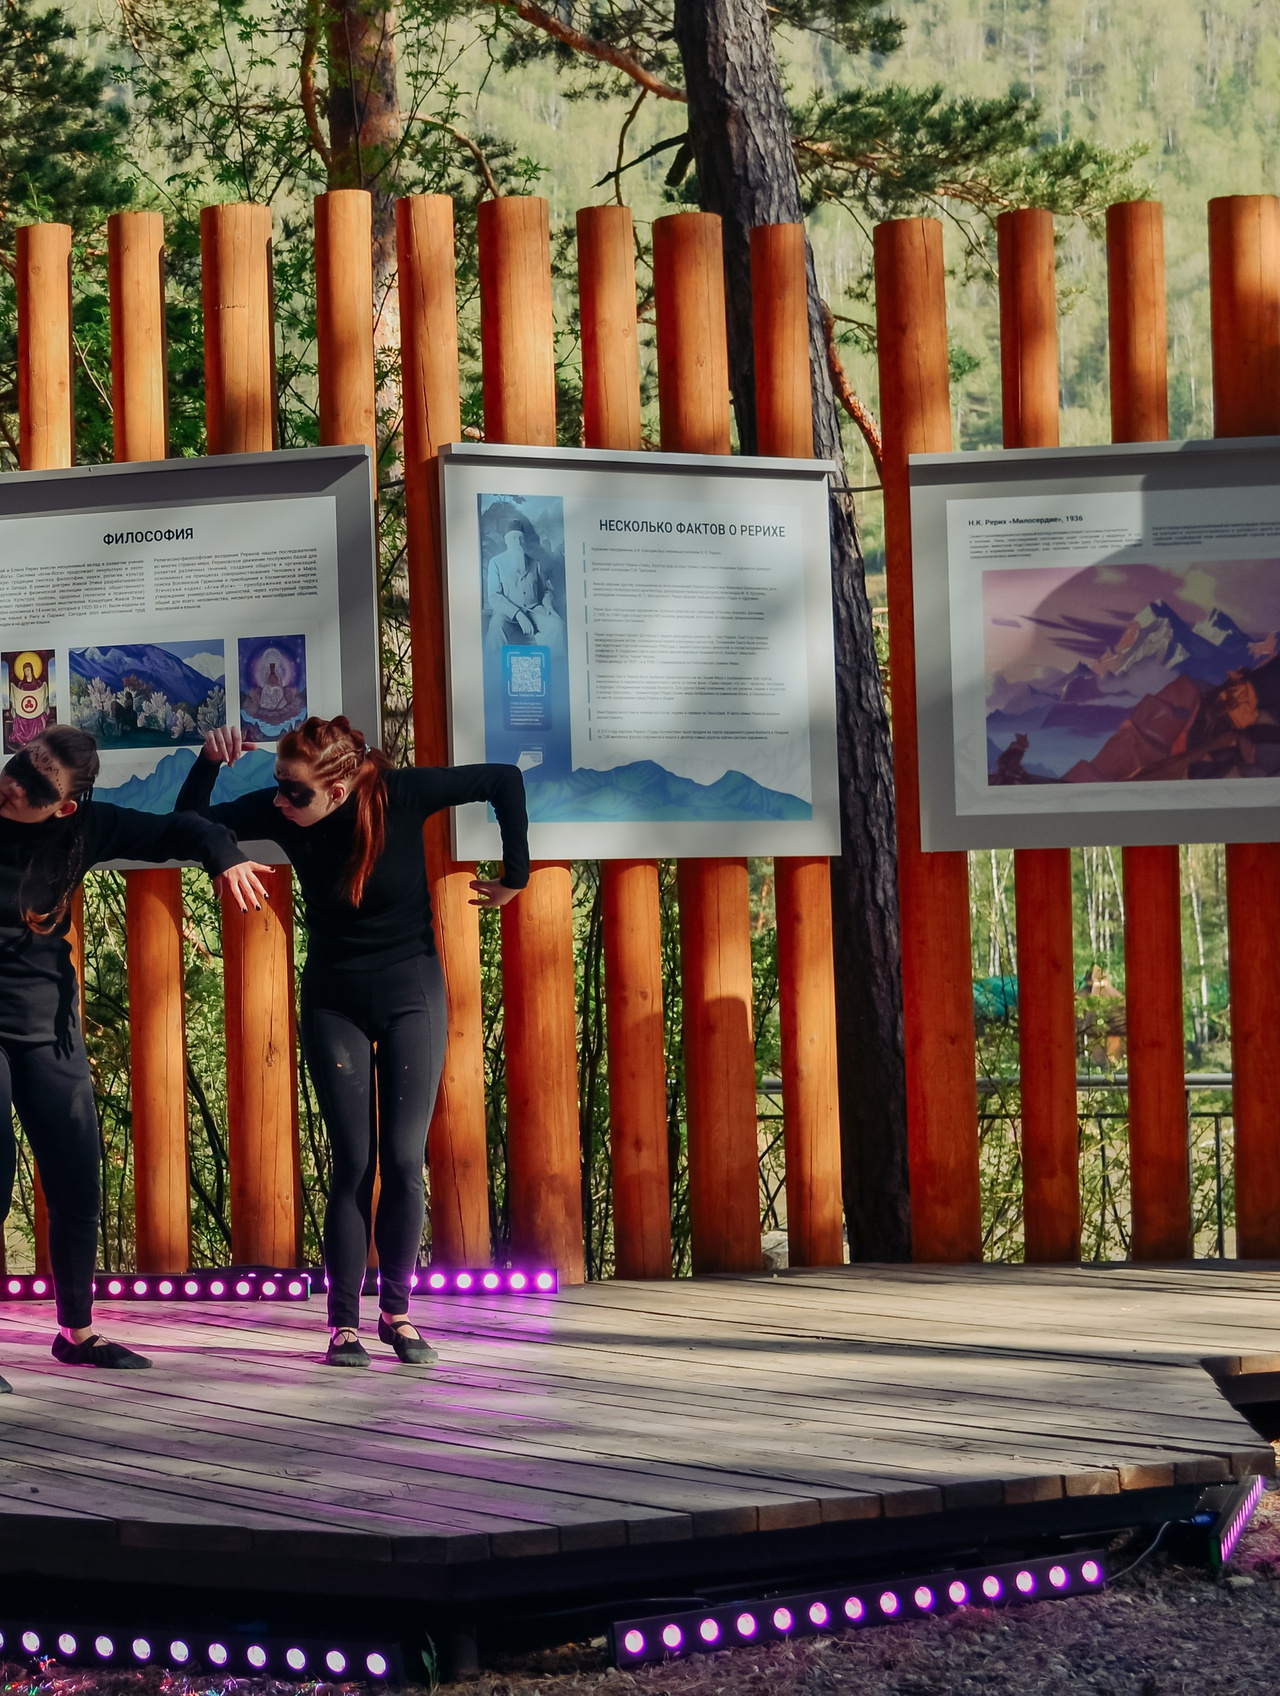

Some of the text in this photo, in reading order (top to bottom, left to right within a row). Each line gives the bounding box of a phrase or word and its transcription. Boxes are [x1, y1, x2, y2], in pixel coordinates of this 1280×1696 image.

[599, 519, 786, 538] НЕСКОЛЬКО ФАКТОВ О РЕРИХЕ
[968, 518, 983, 527] Н.К.
[985, 518, 1007, 528] Рерих
[1065, 514, 1084, 523] 1936
[103, 527, 194, 546] ФИЛОСОФИЯ
